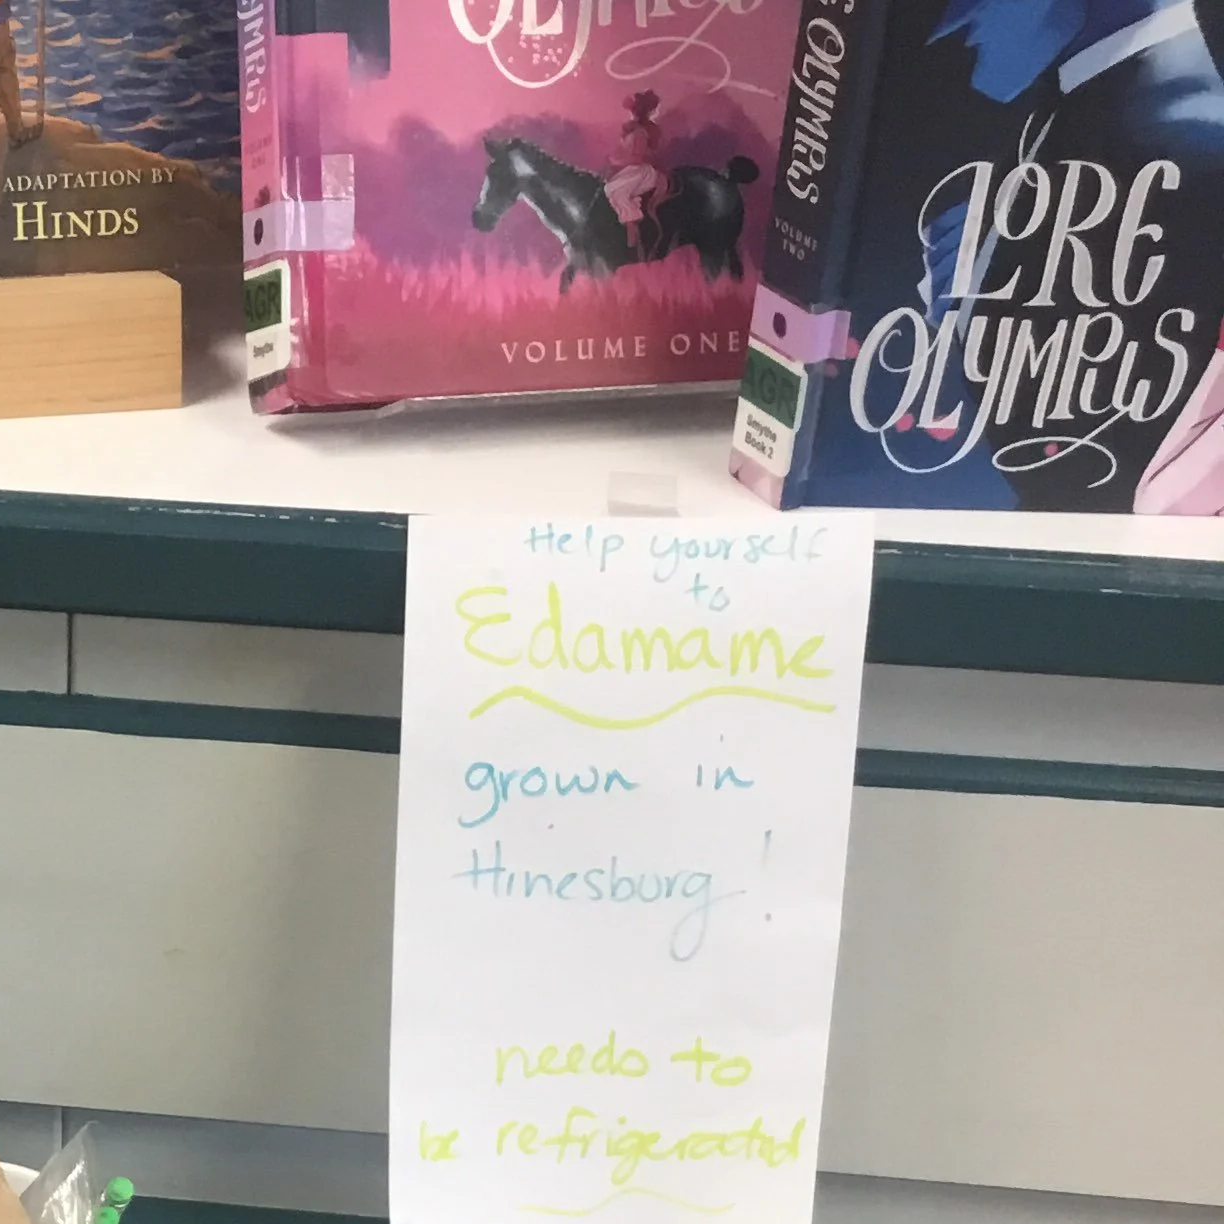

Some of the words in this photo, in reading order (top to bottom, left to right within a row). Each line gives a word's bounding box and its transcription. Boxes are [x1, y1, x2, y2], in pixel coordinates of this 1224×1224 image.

[2, 168, 142, 193] ADAPTATION
[151, 167, 177, 184] BY
[11, 200, 139, 242] HINDS
[775, 217, 818, 251] VOLUME
[918, 158, 1180, 307] LORE
[782, 237, 806, 261] TWO
[500, 336, 647, 364] VOLUME
[669, 330, 740, 355] ONE
[850, 307, 1196, 487] OLYMPUS
[525, 523, 624, 572] Help
[650, 526, 828, 583] yourself
[689, 573, 731, 611] to
[456, 581, 834, 679] Edamame
[458, 761, 639, 828] grown
[695, 733, 754, 789] in
[671, 1035, 753, 1087] to
